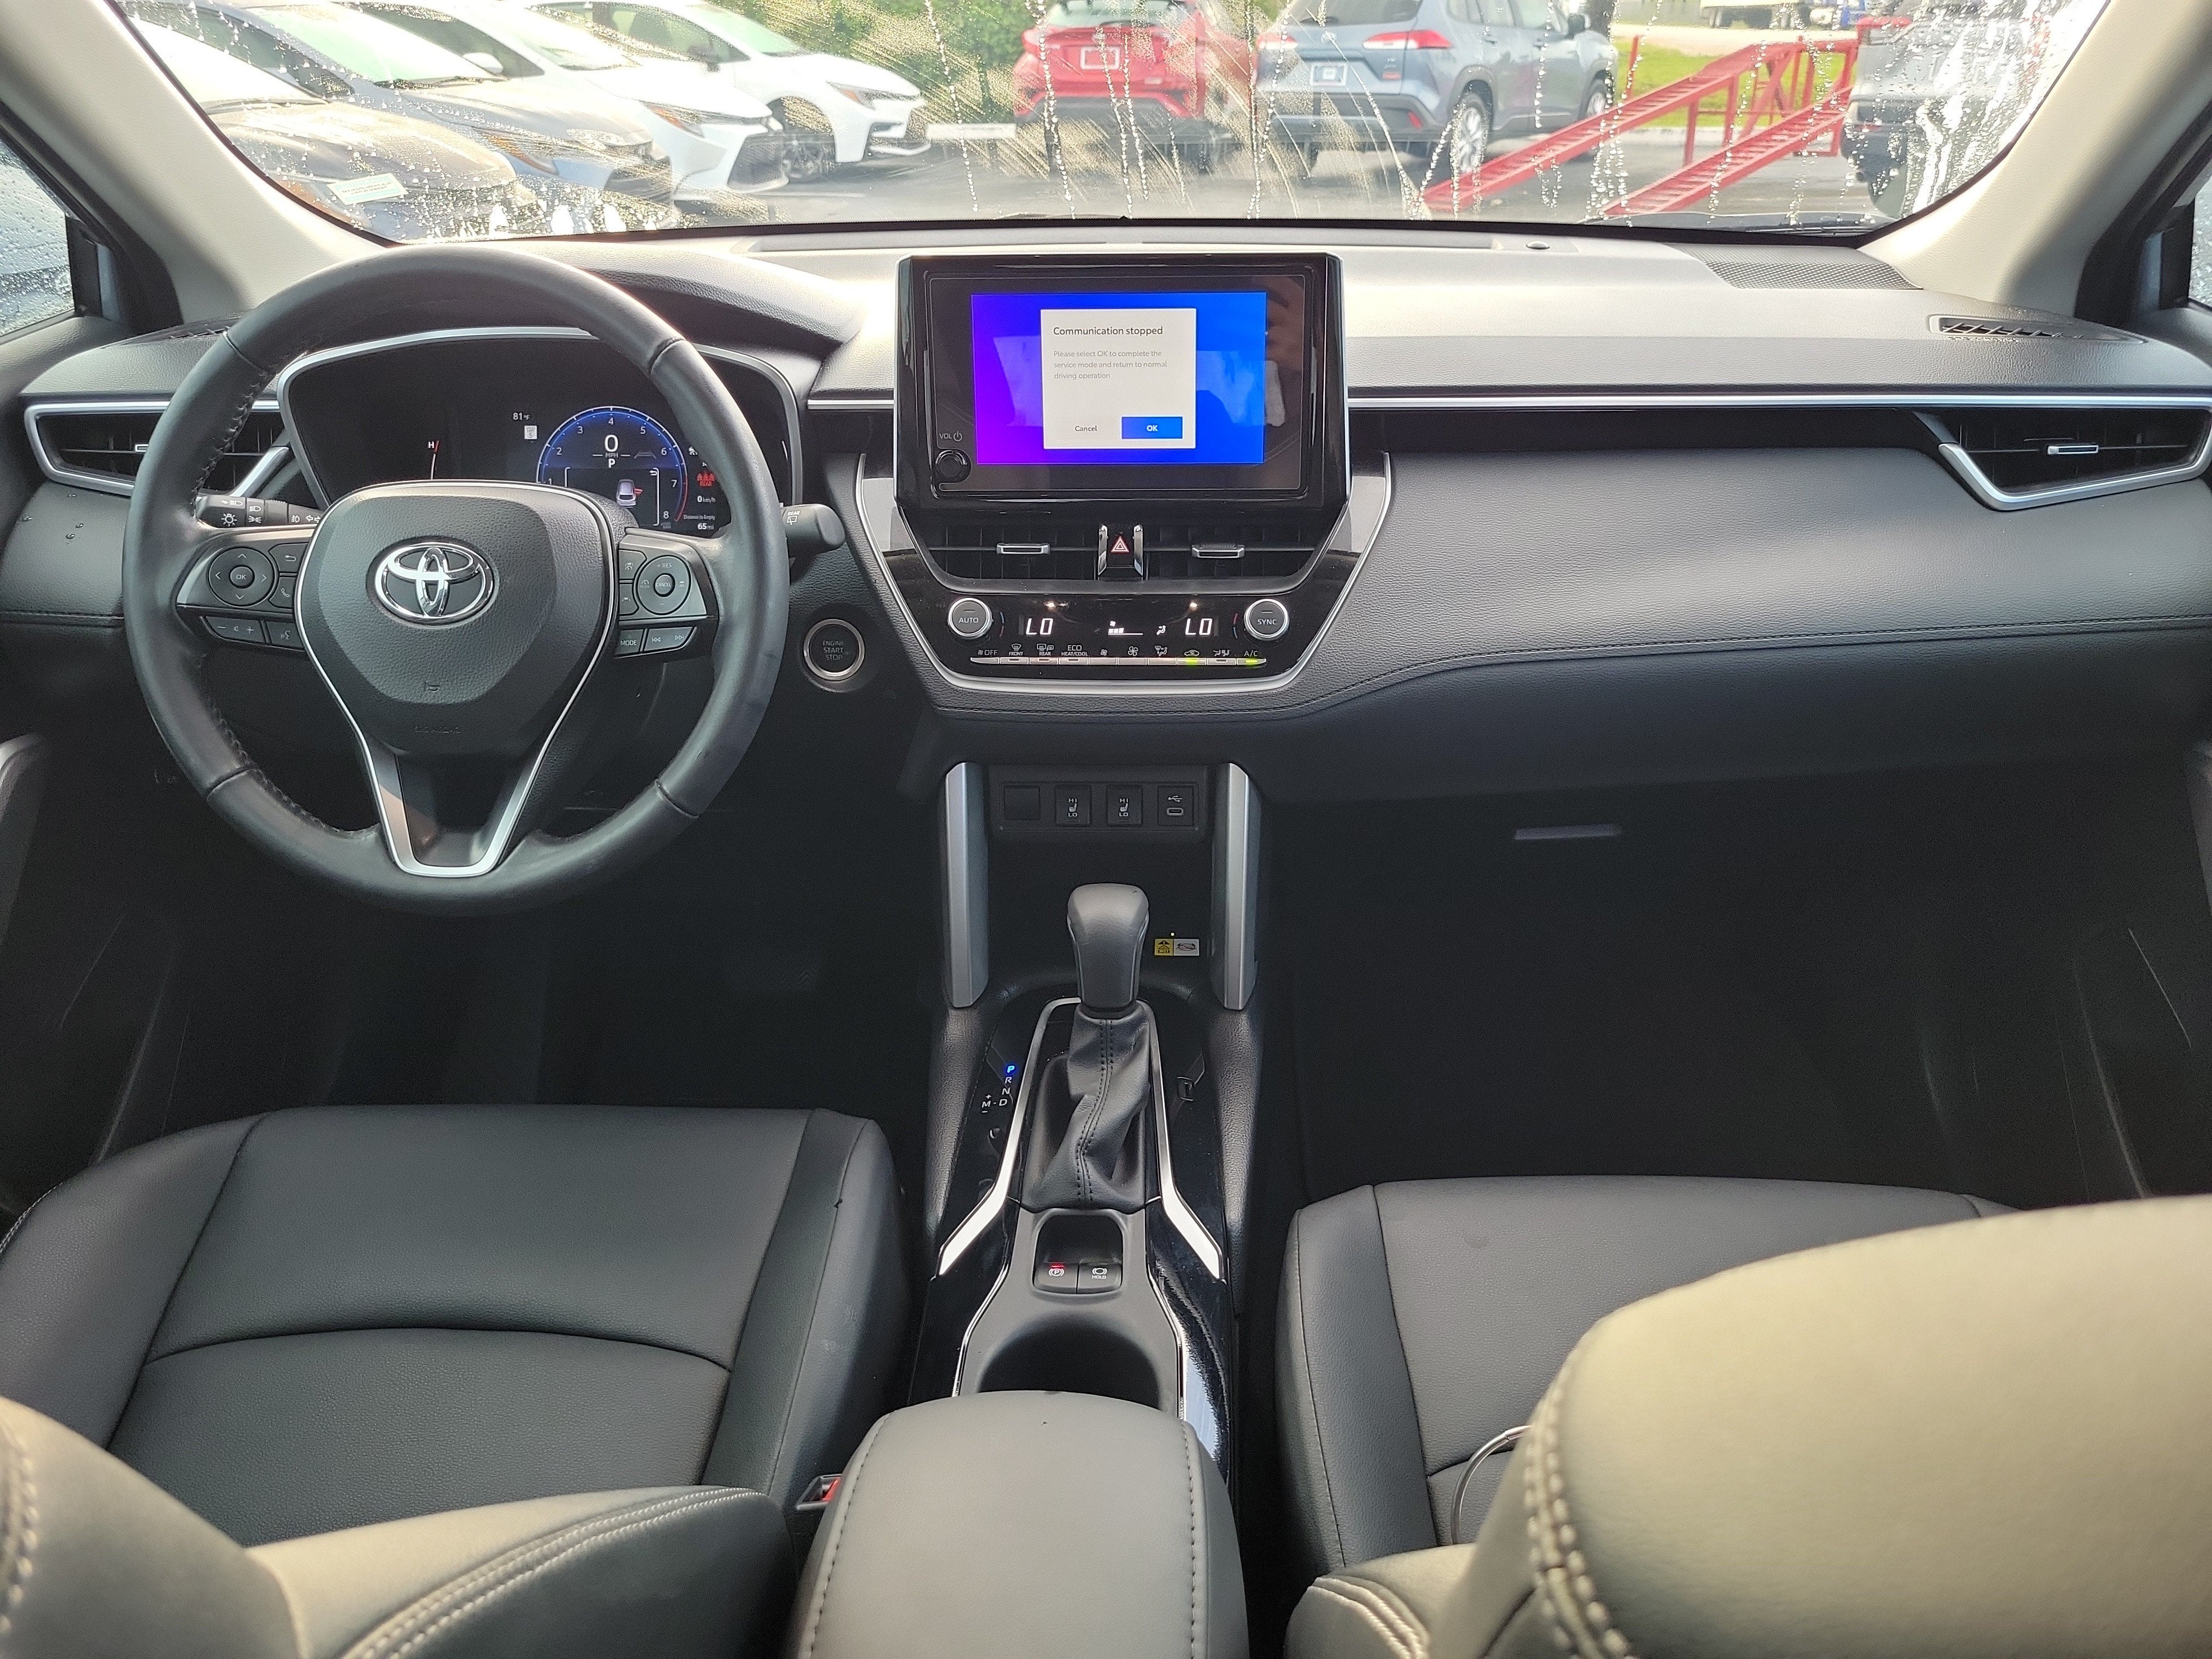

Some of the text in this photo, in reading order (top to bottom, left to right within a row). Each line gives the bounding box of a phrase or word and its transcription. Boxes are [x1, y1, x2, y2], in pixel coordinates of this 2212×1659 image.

[1053, 326, 1163, 336] Communication stopped
[1118, 350, 1149, 358] complete
[1054, 372, 1077, 380] driving
[608, 417, 614, 425] 4
[578, 426, 584, 434] 3
[640, 426, 646, 435] 5
[428, 441, 435, 449] H
[604, 434, 619, 452] 0
[556, 447, 562, 455] 2
[661, 447, 667, 456] 6
[608, 458, 616, 468] P
[671, 479, 678, 488] 7
[663, 511, 669, 519] 8
[1025, 618, 1053, 635] LO
[1184, 618, 1213, 635] LO
[1001, 1087, 1011, 1095] N
